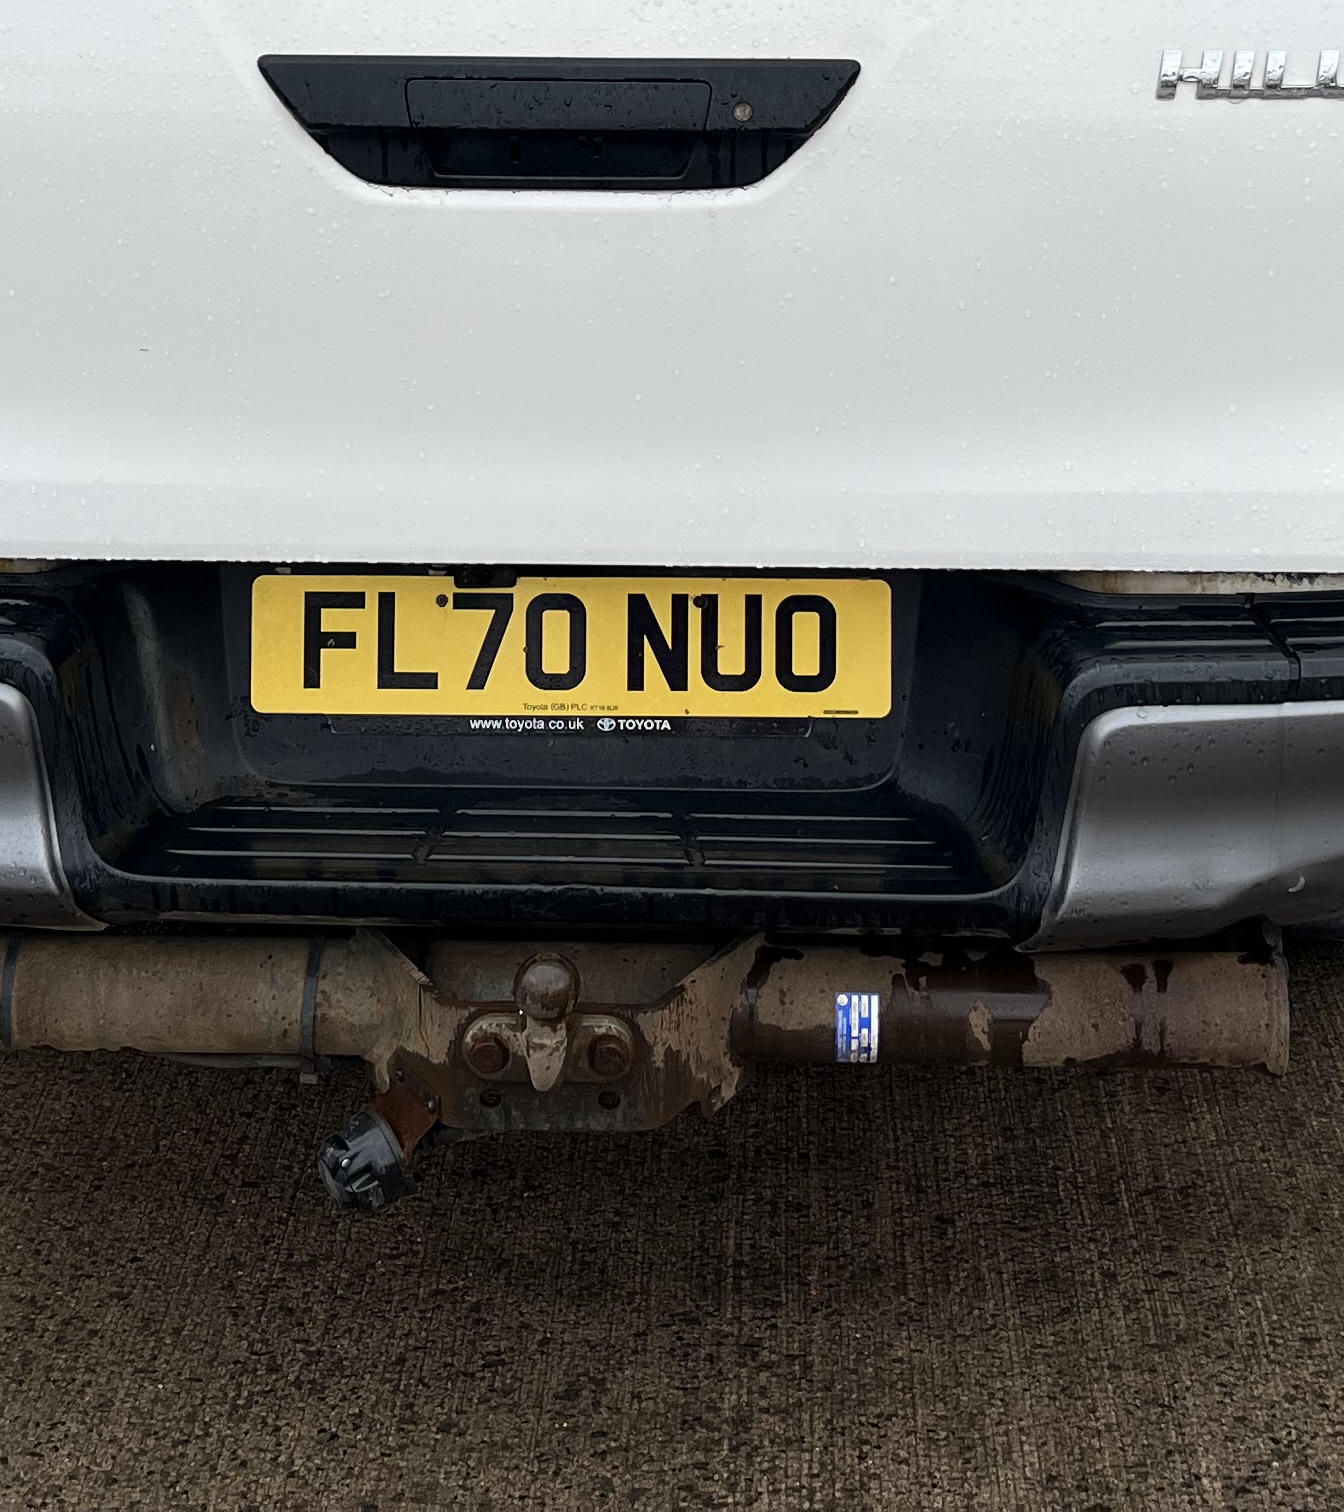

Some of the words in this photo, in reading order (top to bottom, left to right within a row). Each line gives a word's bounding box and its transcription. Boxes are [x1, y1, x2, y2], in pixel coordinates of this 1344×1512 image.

[303, 590, 588, 691] FL70
[626, 592, 838, 694] NUO
[523, 702, 548, 712] Toyota
[469, 717, 585, 733] www.toyota.co.uk
[617, 719, 672, 731] TOYOTA
